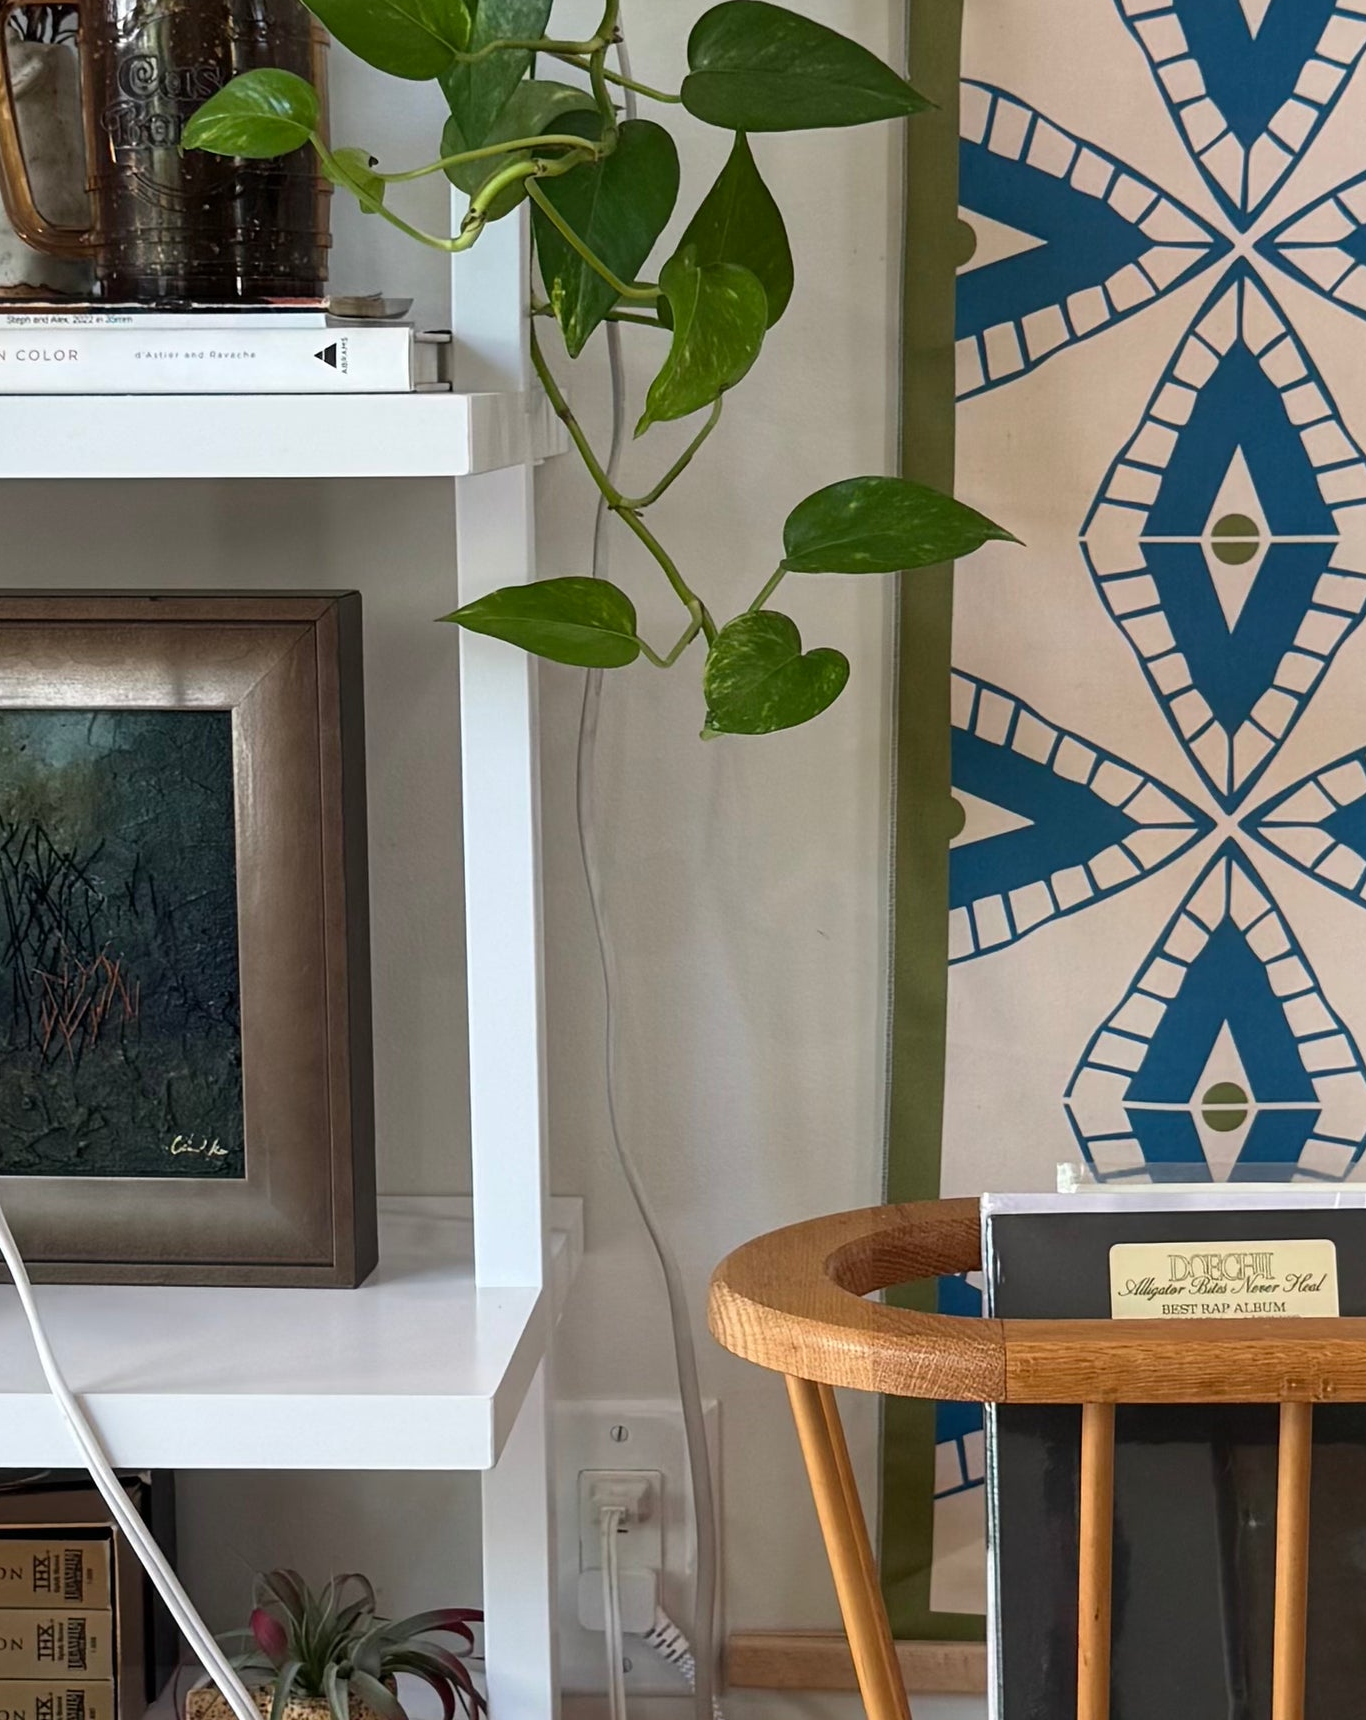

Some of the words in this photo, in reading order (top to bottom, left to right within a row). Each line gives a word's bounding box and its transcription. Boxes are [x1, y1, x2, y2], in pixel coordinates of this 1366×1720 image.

[6, 315, 32, 326] Steph
[32, 315, 49, 324] and
[16, 349, 79, 362] COLOR
[184, 350, 205, 359] and
[1118, 1276, 1186, 1301] Alligator
[1187, 1276, 1228, 1296] Bites
[1231, 1274, 1280, 1294] Never
[1283, 1272, 1329, 1294] Heal
[1161, 1303, 1198, 1315] BEST
[1201, 1303, 1231, 1314] RAP
[1234, 1301, 1287, 1314] ALBUM
[33, 1554, 51, 1593] THX
[37, 1623, 55, 1662] THX
